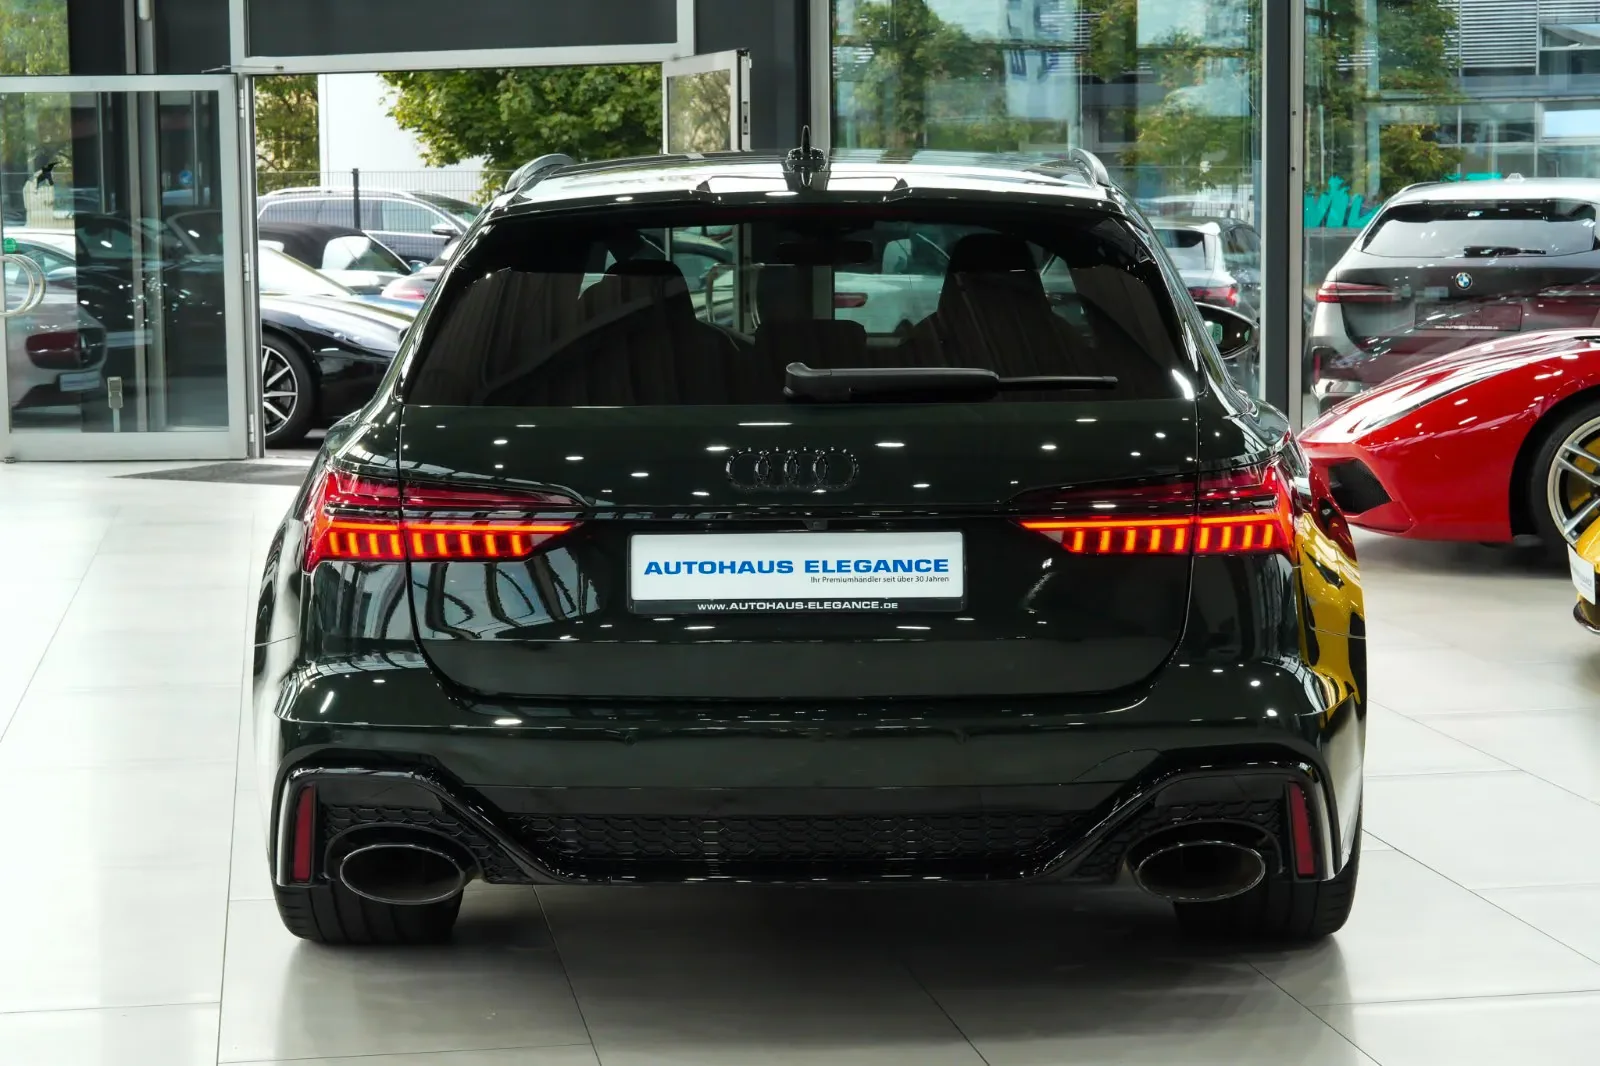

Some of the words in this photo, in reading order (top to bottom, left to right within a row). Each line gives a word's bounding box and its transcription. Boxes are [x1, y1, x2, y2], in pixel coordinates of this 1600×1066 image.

[644, 560, 794, 575] AUTOHAUS
[804, 558, 949, 573] ELEGANCE
[822, 575, 881, 583] Premiumhändler
[897, 575, 913, 583] über
[915, 575, 924, 583] 30
[925, 575, 950, 583] Jahren
